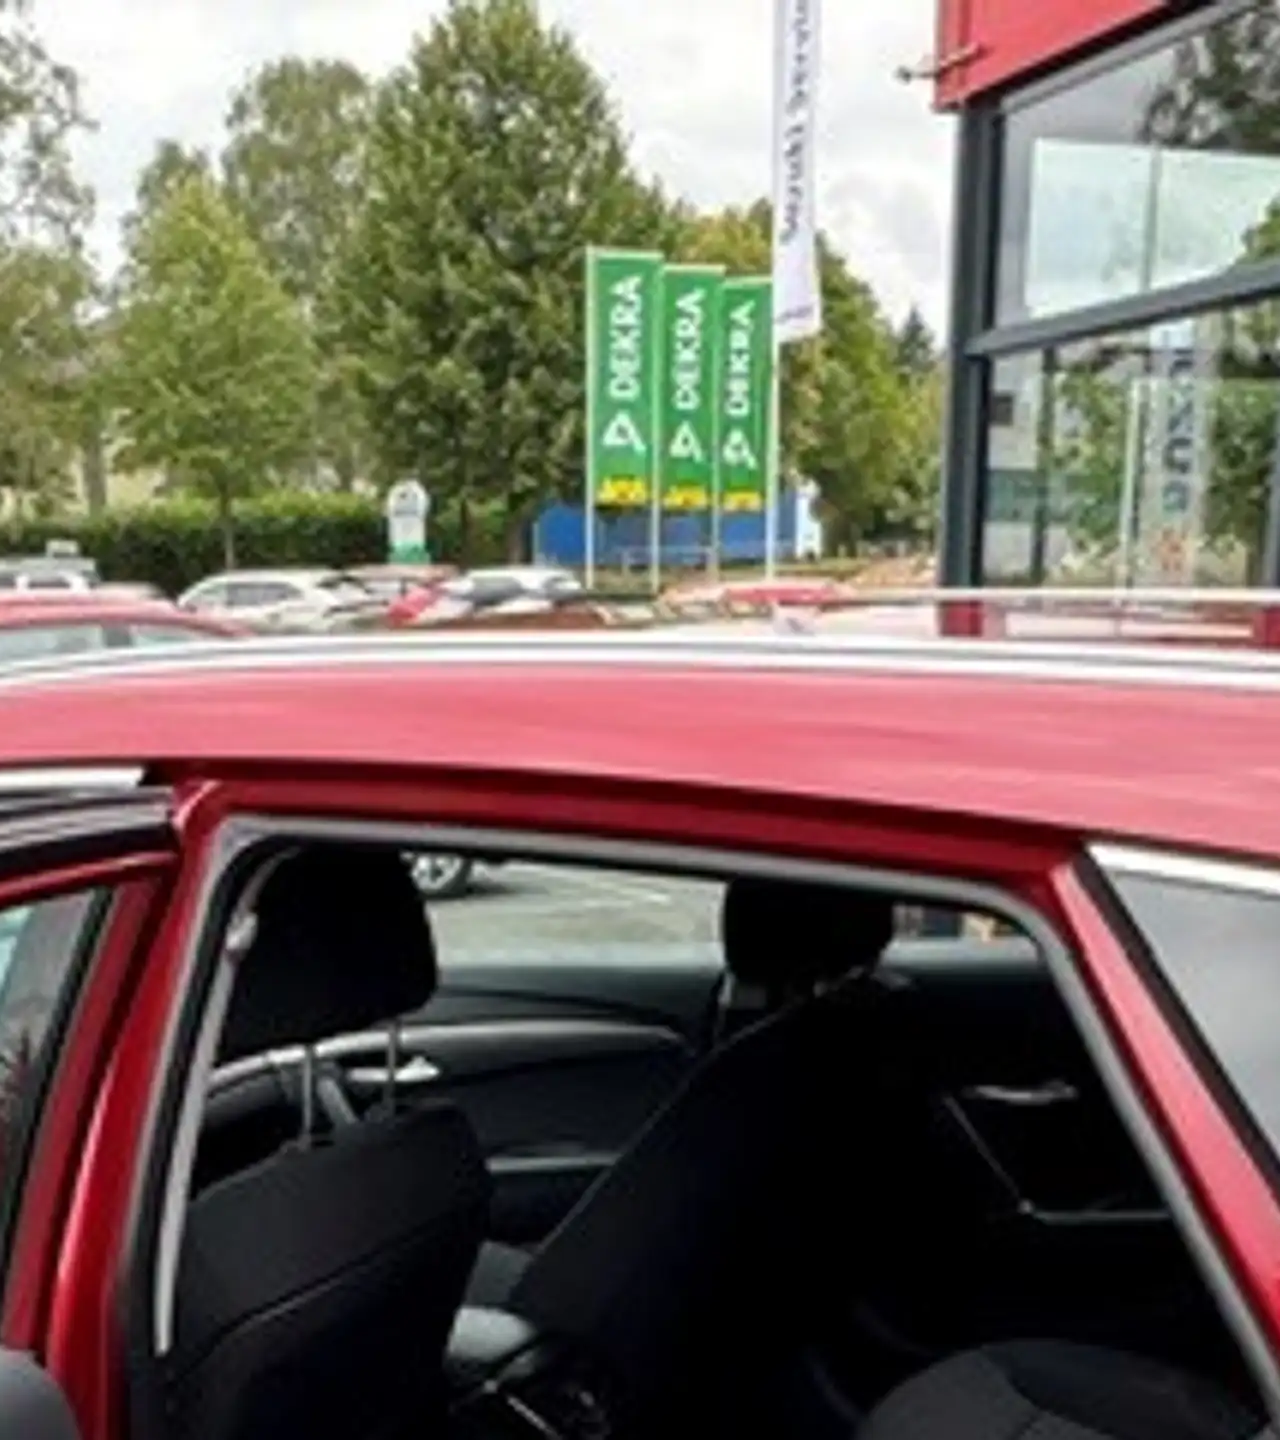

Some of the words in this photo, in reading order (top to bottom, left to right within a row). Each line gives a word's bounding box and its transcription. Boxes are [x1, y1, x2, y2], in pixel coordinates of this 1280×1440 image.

[607, 275, 643, 401] DEKRA
[672, 288, 707, 412] DEKRA
[724, 300, 756, 418] DEKRA
